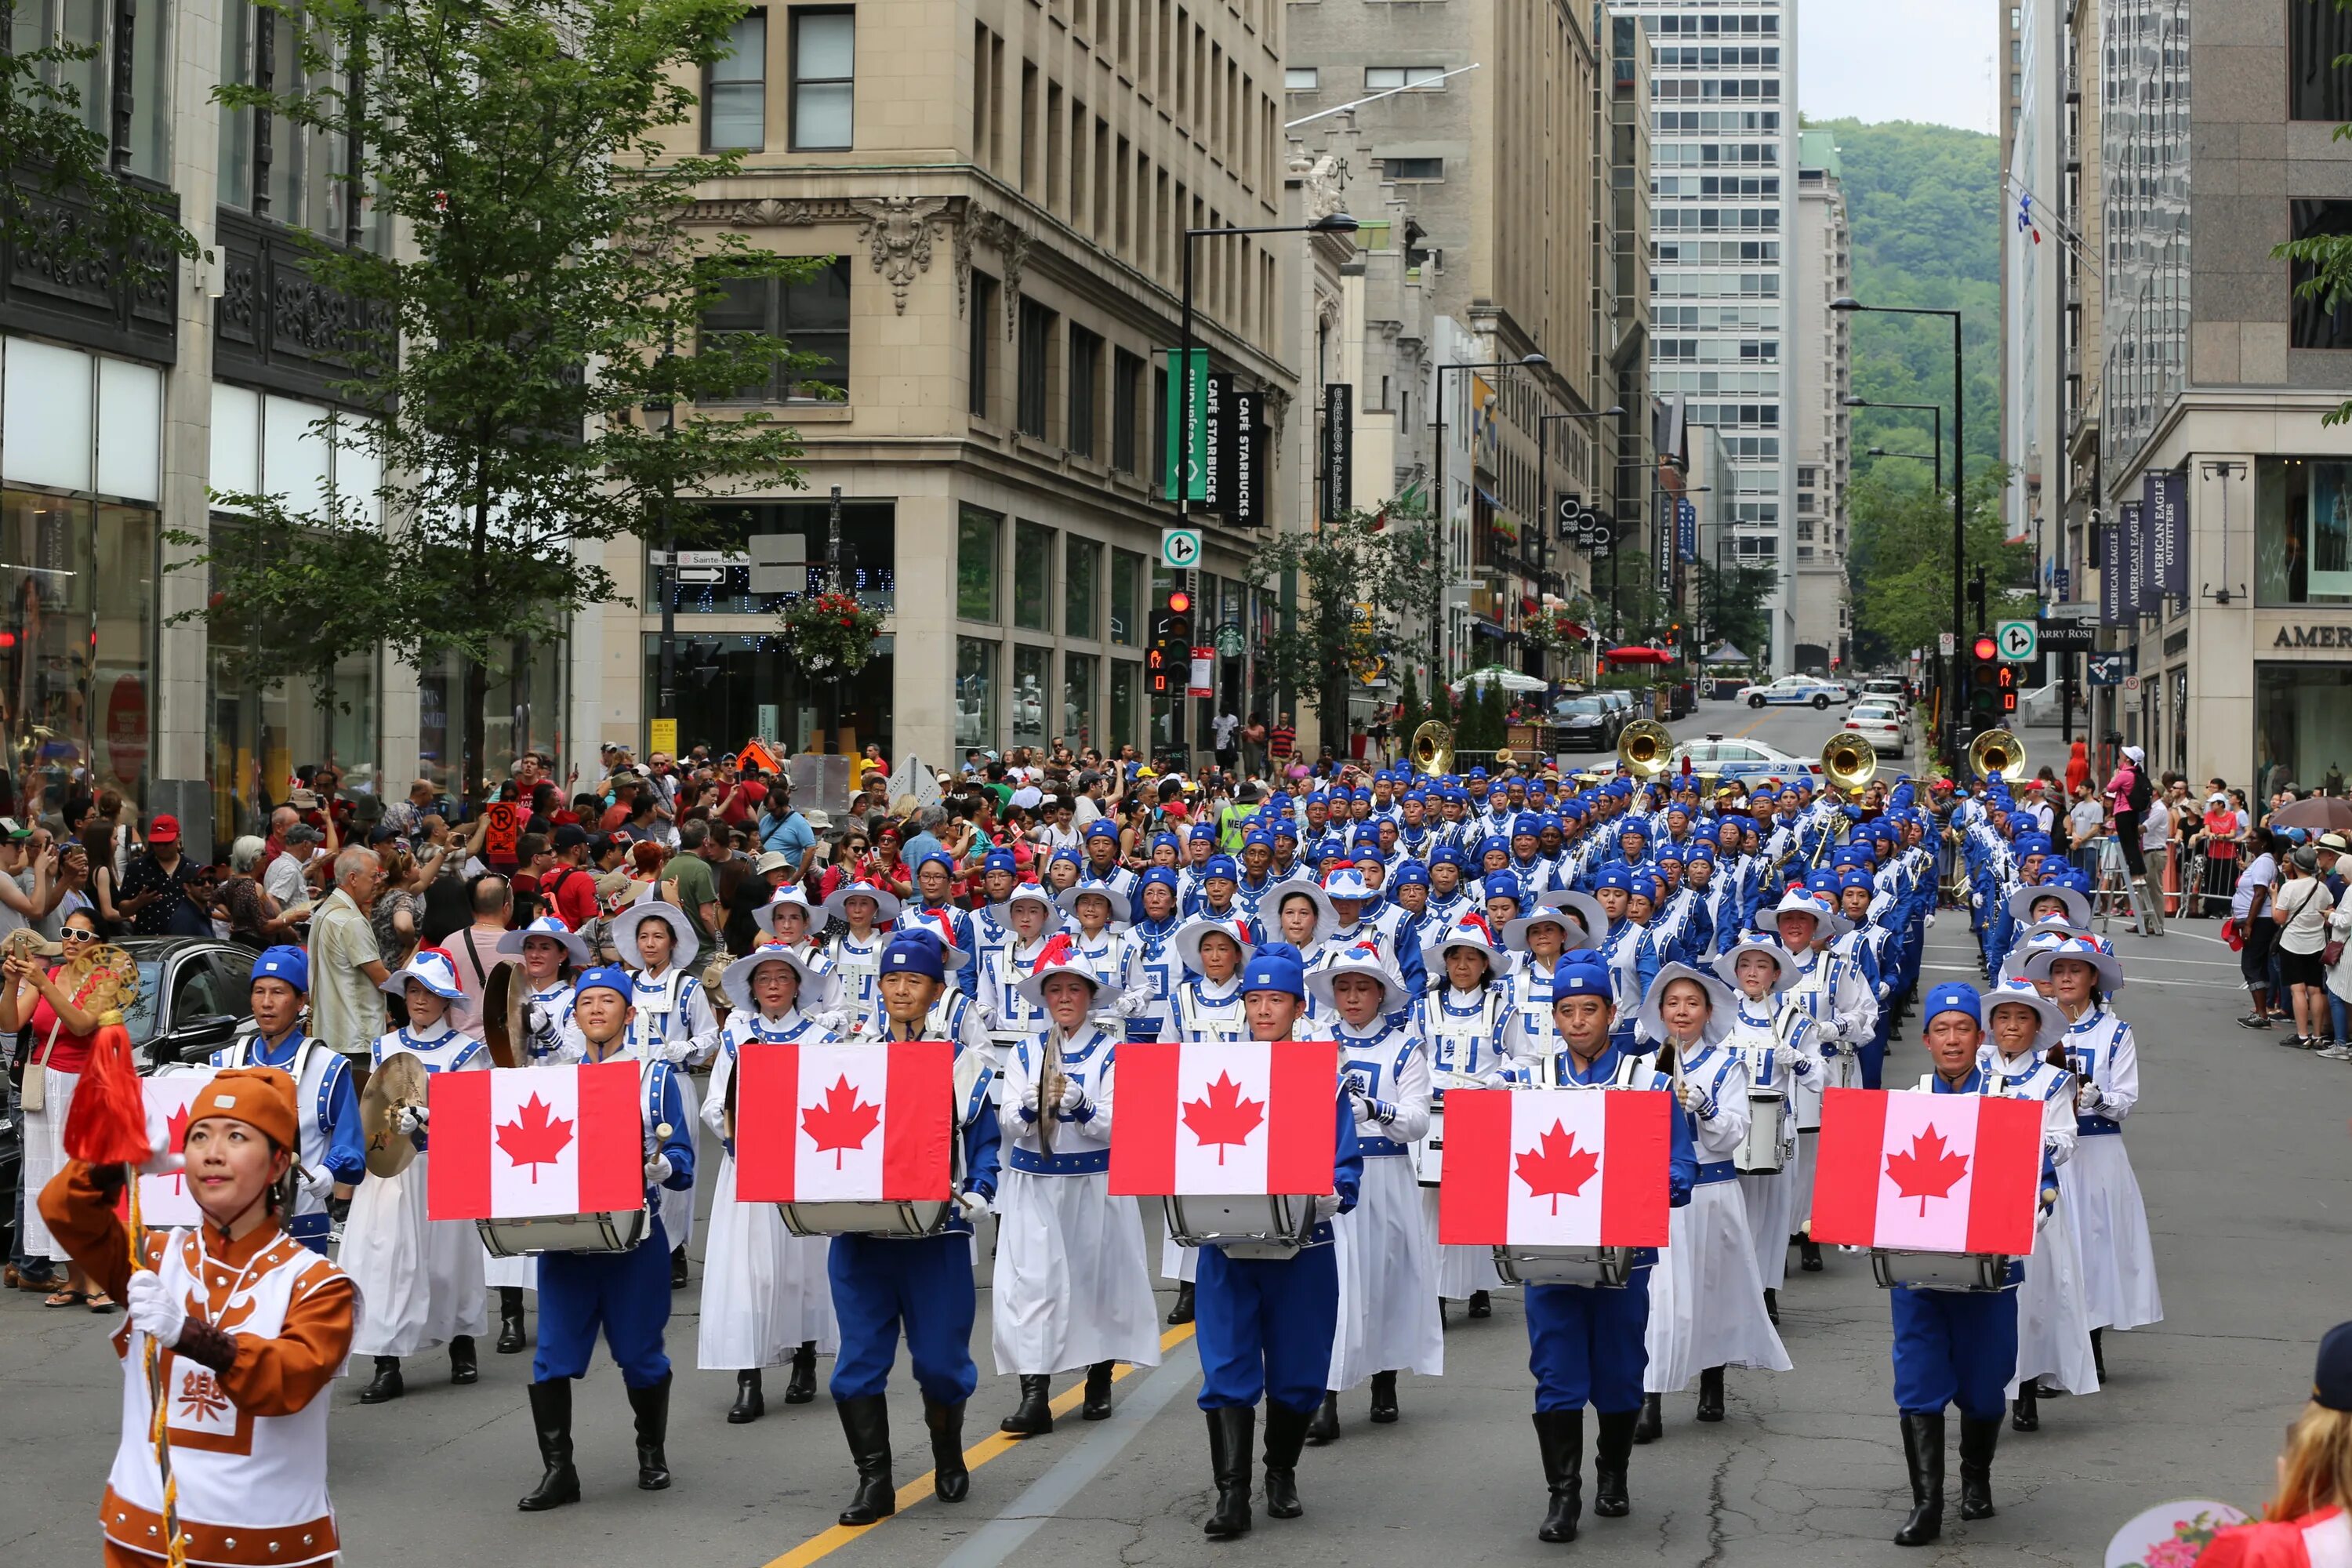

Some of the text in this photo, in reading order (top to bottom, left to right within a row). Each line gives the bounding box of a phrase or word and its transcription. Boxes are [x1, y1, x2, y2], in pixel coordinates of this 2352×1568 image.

[1206, 379, 1220, 503] CAFÉ STARBUCKS
[1239, 397, 1251, 517] CAFÉ STARBUCKS
[1333, 387, 1343, 453] CARLOS
[2110, 532, 2118, 621] AMERICAN EAGLE
[2130, 510, 2140, 608] AMERICAN EAGLE
[2154, 480, 2165, 589] AMERICAN EAGLE
[2165, 503, 2174, 566] OUTFITTERS
[2274, 626, 2352, 647] AMER
[178, 1370, 229, 1423] 樂
